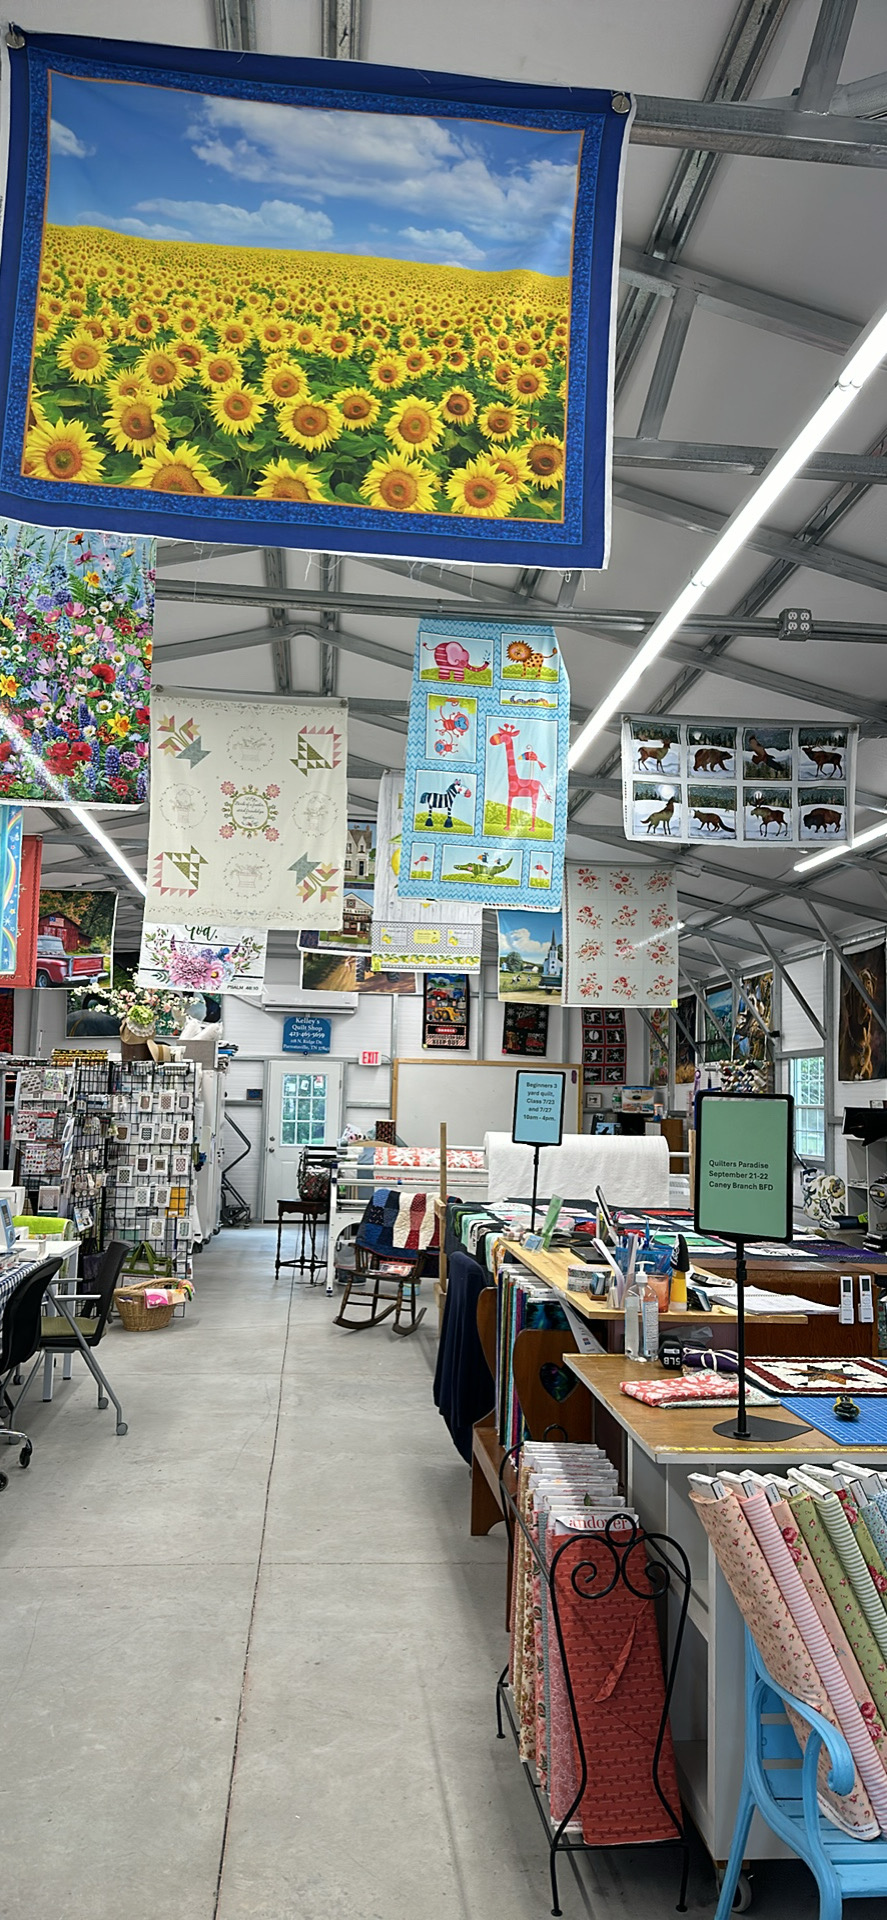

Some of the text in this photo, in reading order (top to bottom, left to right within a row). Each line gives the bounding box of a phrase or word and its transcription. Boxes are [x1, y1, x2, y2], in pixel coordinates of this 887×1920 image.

[296, 1017, 320, 1025] Kelley's
[308, 1024, 323, 1032] Shop
[362, 1051, 379, 1064] EXIT
[738, 1161, 769, 1169] Paradise
[709, 1170, 747, 1179] September
[709, 1181, 731, 1190] Caney
[733, 1182, 758, 1190] Branch
[663, 1357, 681, 1365] 5LB
